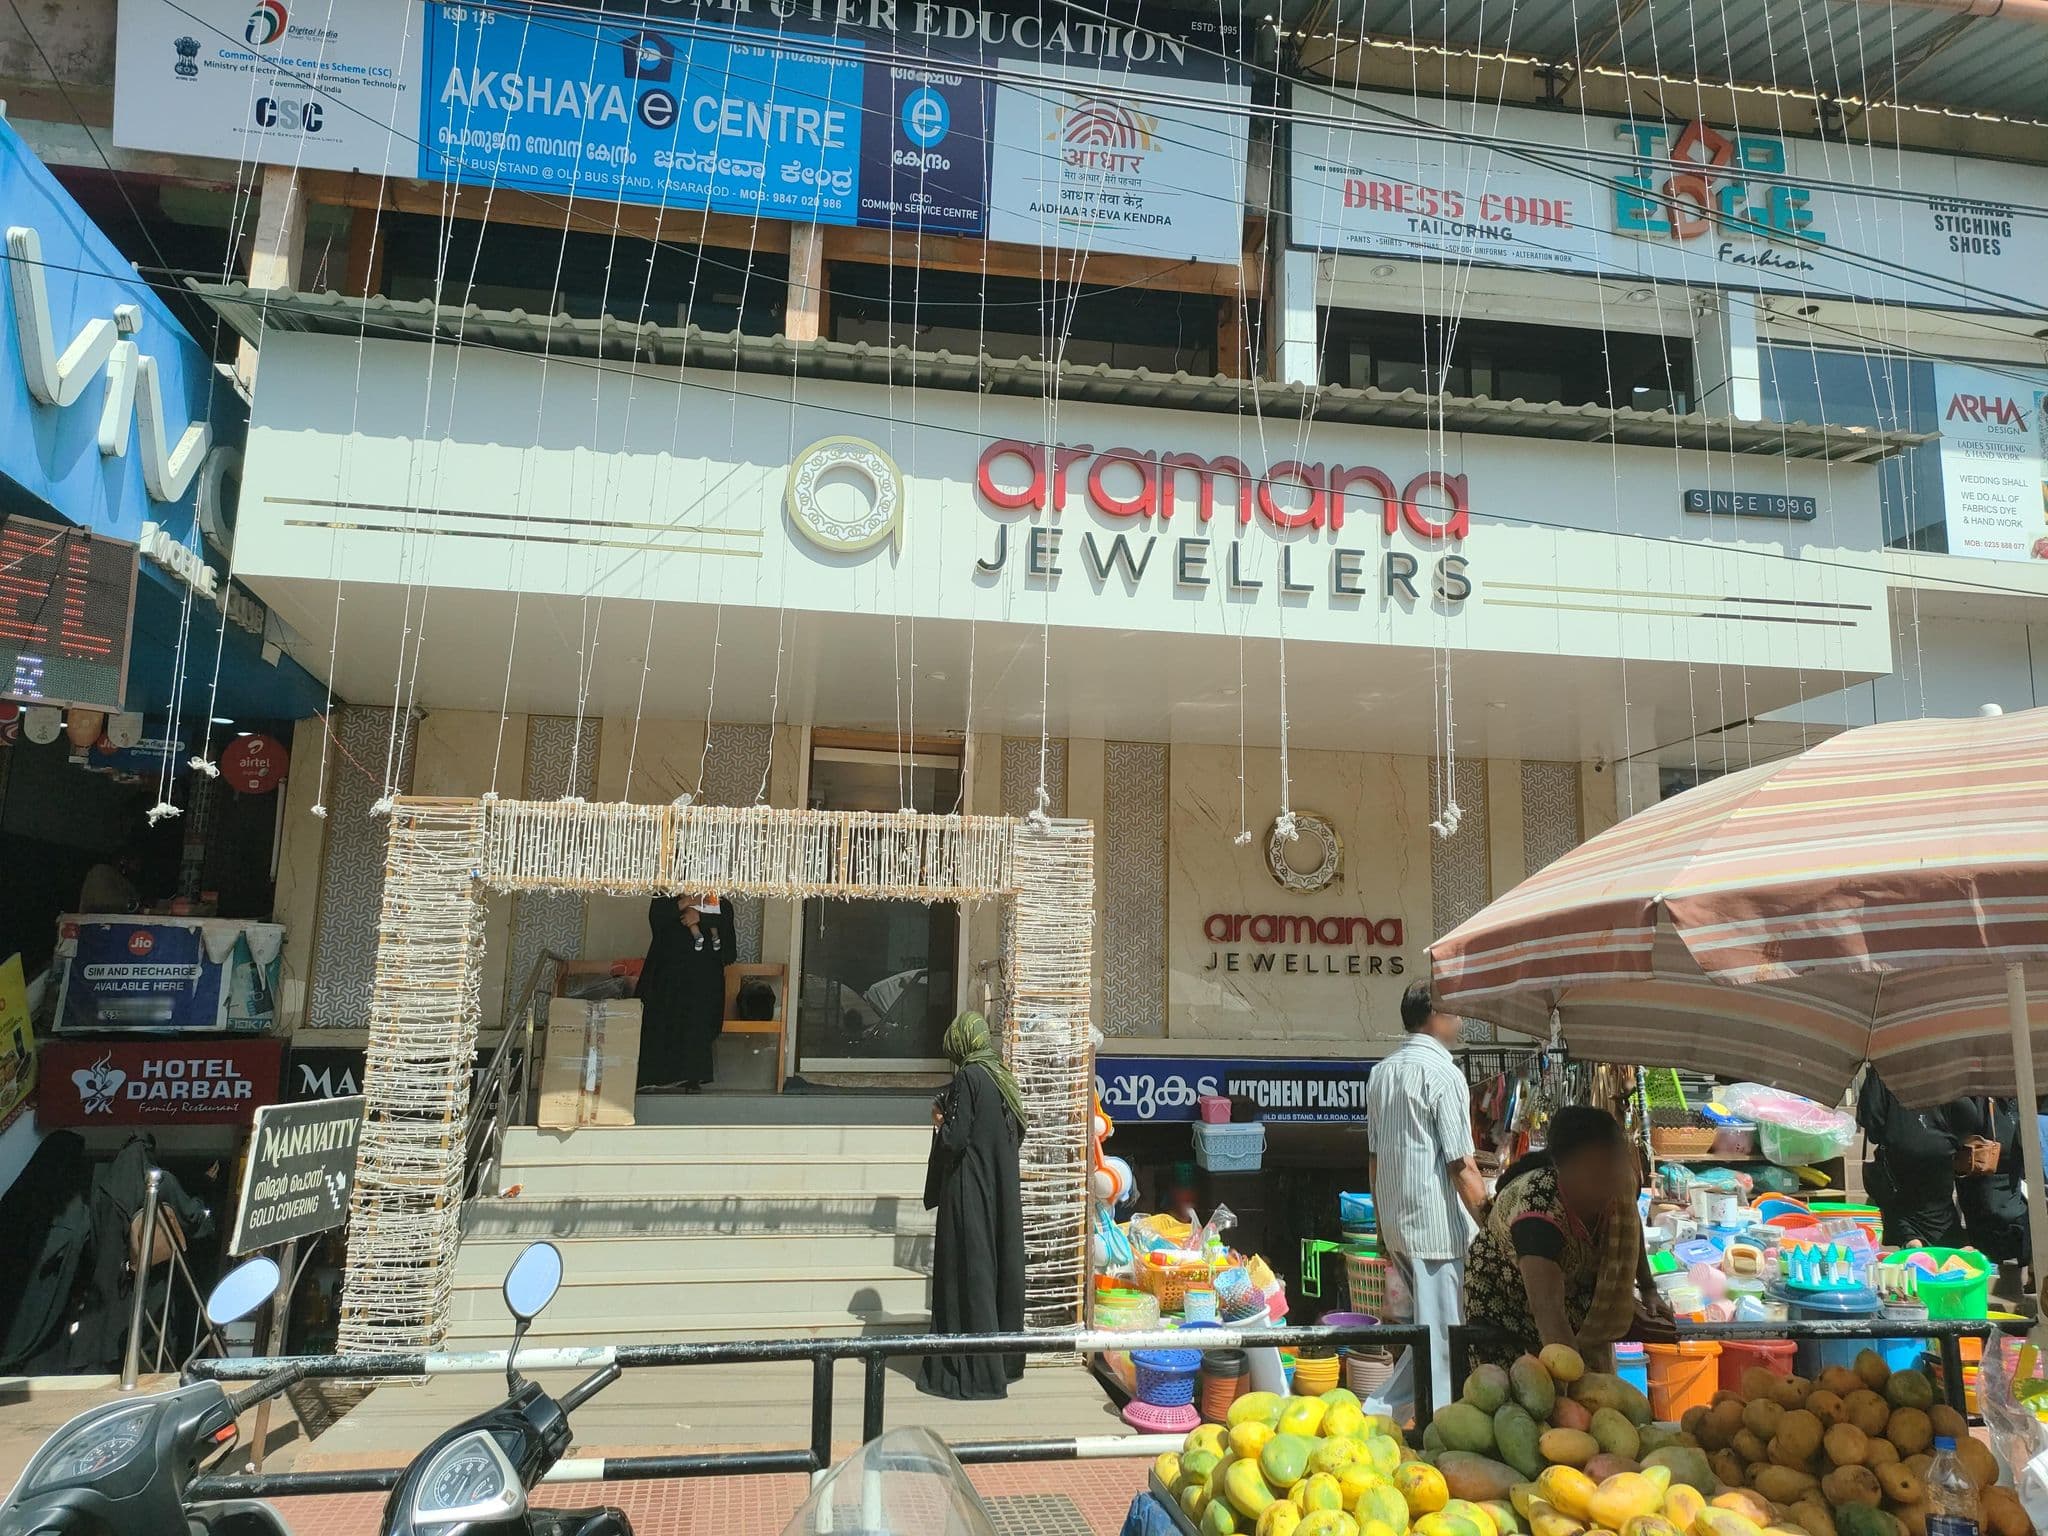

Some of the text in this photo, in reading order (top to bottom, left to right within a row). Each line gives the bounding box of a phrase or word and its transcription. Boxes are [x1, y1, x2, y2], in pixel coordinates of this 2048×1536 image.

[443, 7, 496, 25] KSD 125
[1191, 22, 1216, 33] ESTD:
[288, 25, 338, 39] Digital India
[912, 2, 1189, 66] EDUCATION
[218, 49, 392, 78] Common Service Centres Scheme (CSC)
[204, 60, 237, 72] Ministry
[239, 63, 249, 72] of
[296, 70, 311, 79] and
[313, 73, 360, 84] Information
[362, 77, 406, 91] Technology
[269, 79, 342, 94] Government of India
[255, 97, 323, 132] CSC
[440, 67, 845, 147] AKSHAYA e CENTRE
[912, 98, 942, 138] e
[526, 134, 581, 158] സേവന
[1062, 149, 1144, 173] आधार
[440, 156, 468, 168] NEW
[471, 159, 495, 171] BUS
[500, 163, 538, 176] STAND
[542, 168, 554, 179] @
[558, 169, 581, 181] OLD
[585, 172, 609, 184] BUS
[612, 175, 654, 189] STAND,
[657, 178, 729, 197] KASARAGOD
[740, 188, 769, 202] MOB:
[773, 193, 797, 204] 9847
[823, 199, 842, 209] 986
[909, 193, 932, 204] (CSC)
[1061, 189, 1095, 202] आधार
[1097, 190, 1118, 205] सेवा
[1344, 178, 1574, 229] DRESS CODE
[861, 198, 978, 220] COMMON SERVICE CENTRE
[1030, 202, 1172, 226] AADHAAR SEVA KENDRA
[1610, 174, 1827, 250] EDGE
[1408, 218, 1513, 241] TAILORING
[1934, 214, 2012, 238] STICHING
[1350, 234, 1371, 244] PANTS
[1475, 247, 1507, 257] UNIFORMS
[1515, 251, 1553, 261] ALTERATION
[1555, 253, 1573, 263] WORK
[1718, 243, 1814, 270] Fashion
[1949, 235, 2001, 256] SHOES
[1946, 393, 2028, 432] ARHA
[1987, 425, 2020, 436] DESIGN
[1957, 440, 2025, 454] LADIES STITCHING
[1971, 450, 1995, 460] HAND
[1997, 452, 2020, 462] WORK
[976, 437, 1469, 540] aramana
[1959, 475, 2029, 488] WEDDING SHALL
[1693, 492, 1813, 516] SINCE 1996
[1961, 491, 2019, 504] WE DO ALL OF
[1962, 503, 2017, 516] FABRICS DYE
[1971, 517, 1995, 527] HAND
[1997, 519, 2024, 529] WORK
[975, 523, 1472, 603] JEWELLERS
[240, 757, 270, 768] airtel
[1204, 913, 1404, 946] aramana
[131, 937, 151, 948] Jio
[88, 966, 196, 976] SIM AND RECHARGE
[1205, 952, 1404, 975] JEWELLERS
[93, 982, 184, 991] AVAILABLE HERE
[142, 1059, 241, 1078] HOTEL
[127, 1080, 253, 1100] DARBAR
[1229, 1080, 1368, 1107] KITCHEN PLASTI
[139, 1102, 240, 1116] Family Restaurant
[261, 1118, 360, 1168] MANAVATTY
[250, 1195, 320, 1229] GOLD COVERING
